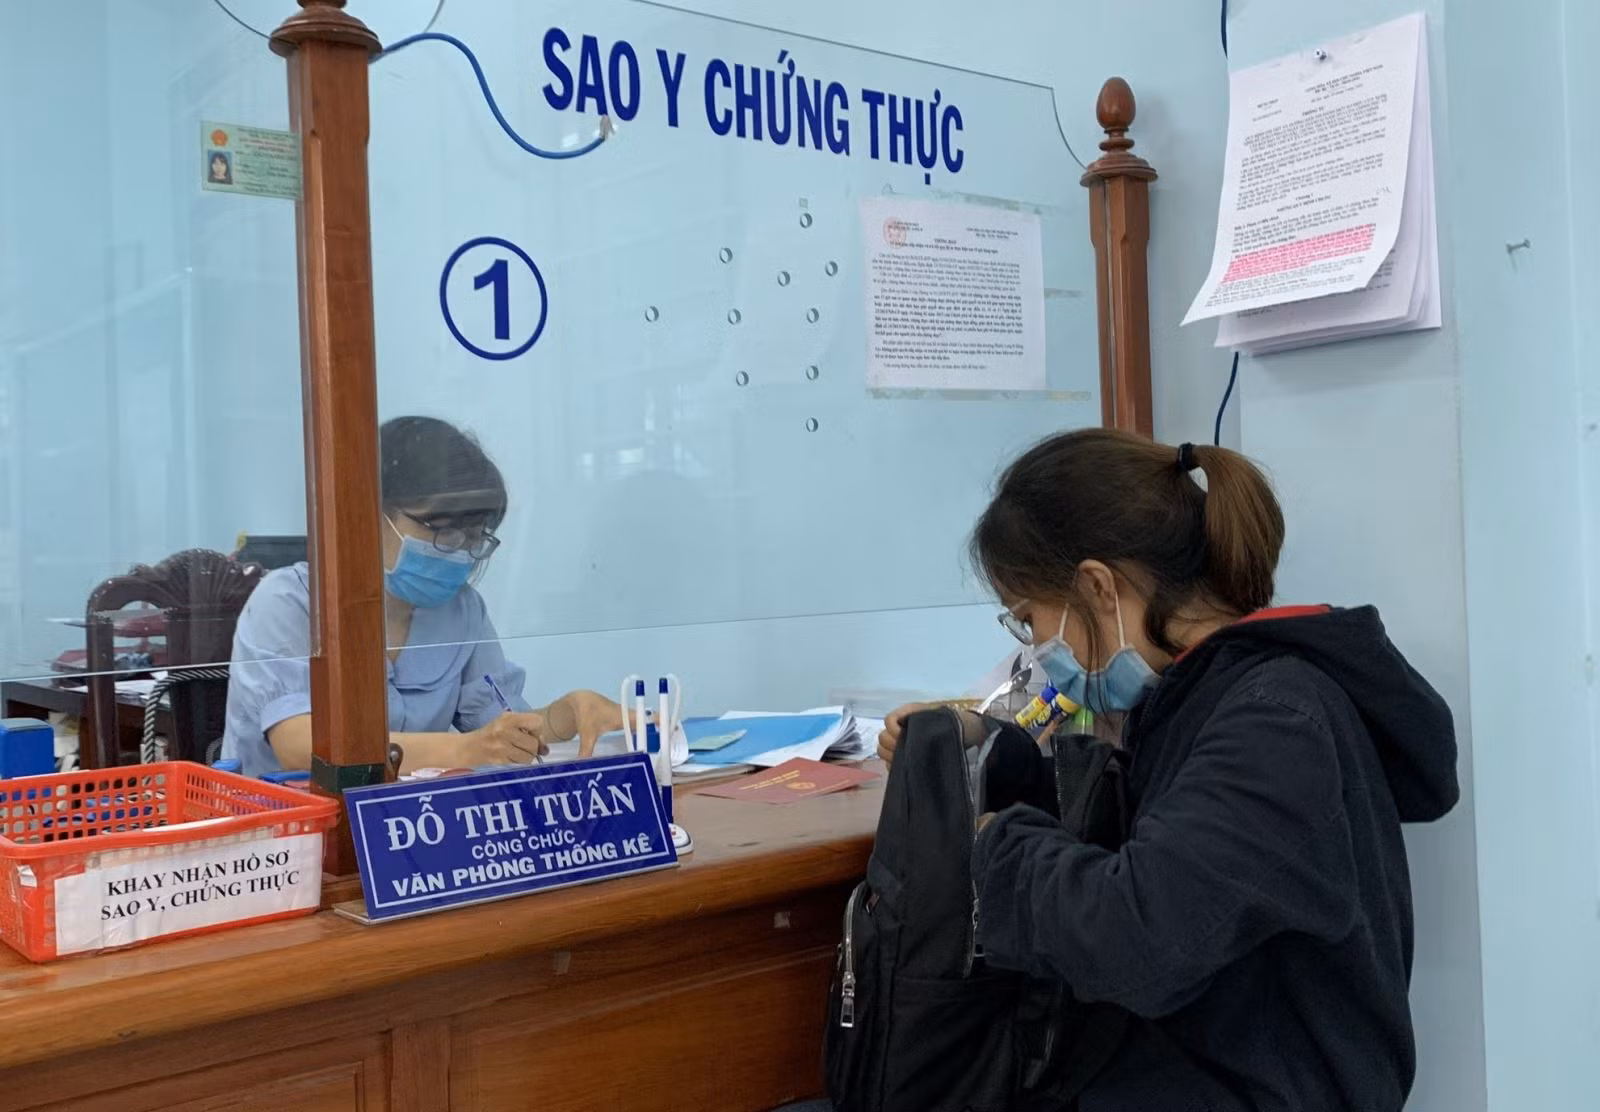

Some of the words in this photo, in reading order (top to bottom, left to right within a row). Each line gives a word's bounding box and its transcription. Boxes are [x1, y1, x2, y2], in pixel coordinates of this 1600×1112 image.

[542, 27, 640, 122] SAO
[656, 48, 687, 128] Y
[704, 49, 850, 156] CHỨNG
[861, 88, 964, 185] THỰC
[474, 258, 510, 340] 1
[384, 795, 446, 851] ĐỖ
[455, 799, 529, 840] THỊ
[534, 772, 636, 825] TUẤN
[107, 873, 166, 897] KHAY
[172, 860, 228, 887] NHẬN
[265, 849, 290, 869] SƠ
[392, 872, 446, 897] VĂN
[453, 857, 536, 887] PHÒNG
[544, 838, 619, 871] THỐNG
[623, 832, 653, 856] KÊ
[471, 838, 524, 861] CÔNG
[528, 829, 576, 850] CHỨC
[101, 899, 141, 921] SAO
[148, 897, 166, 912] Y,
[170, 881, 241, 907] CHỨNG
[246, 869, 300, 892] THỰC
